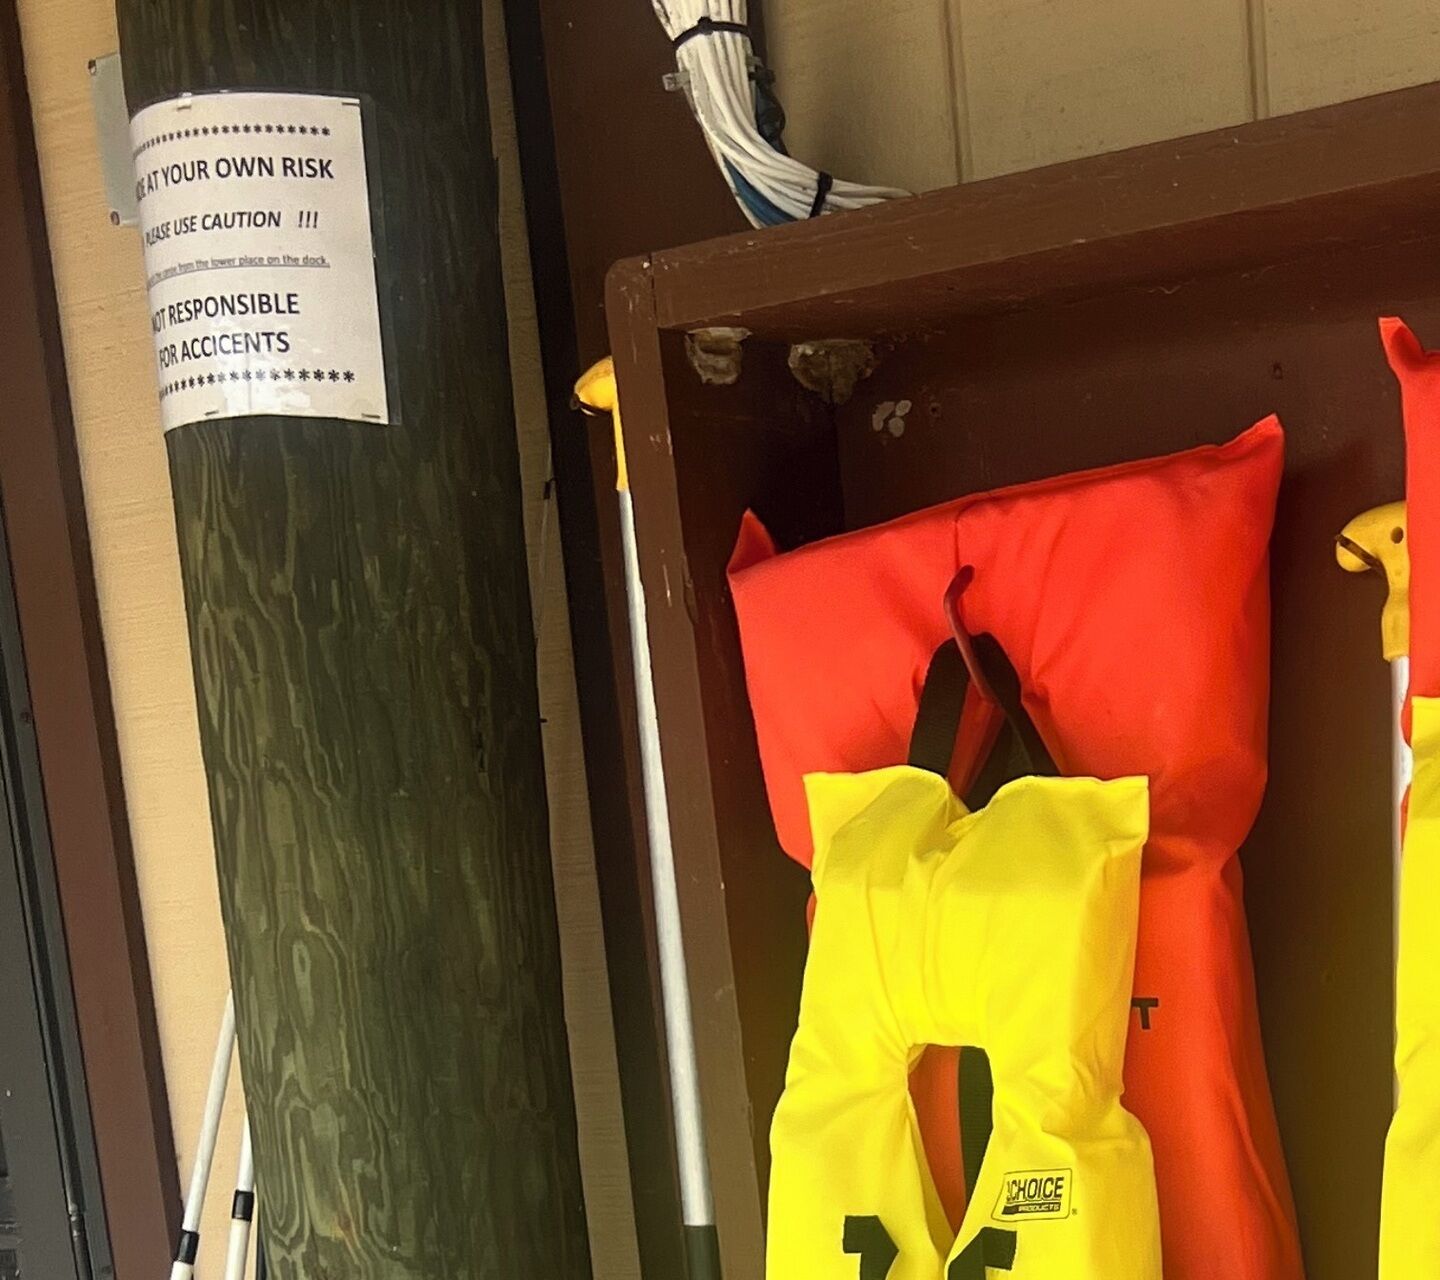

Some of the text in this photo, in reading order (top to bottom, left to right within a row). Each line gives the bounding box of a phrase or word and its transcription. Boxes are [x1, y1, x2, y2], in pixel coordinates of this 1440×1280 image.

[148, 170, 159, 194] AT
[161, 160, 210, 187] YOUR
[215, 156, 274, 179] OWN
[281, 156, 335, 180] RISK
[173, 215, 198, 237] USE
[201, 210, 282, 231] CAUTION
[297, 210, 319, 230] !!!
[211, 257, 236, 268] lower
[238, 255, 265, 267] place
[266, 256, 280, 265] on
[282, 254, 300, 265] the
[167, 292, 301, 327] RESPONSIBLE
[158, 344, 179, 371] FOR
[1006, 1176, 1065, 1202] CHOICE
